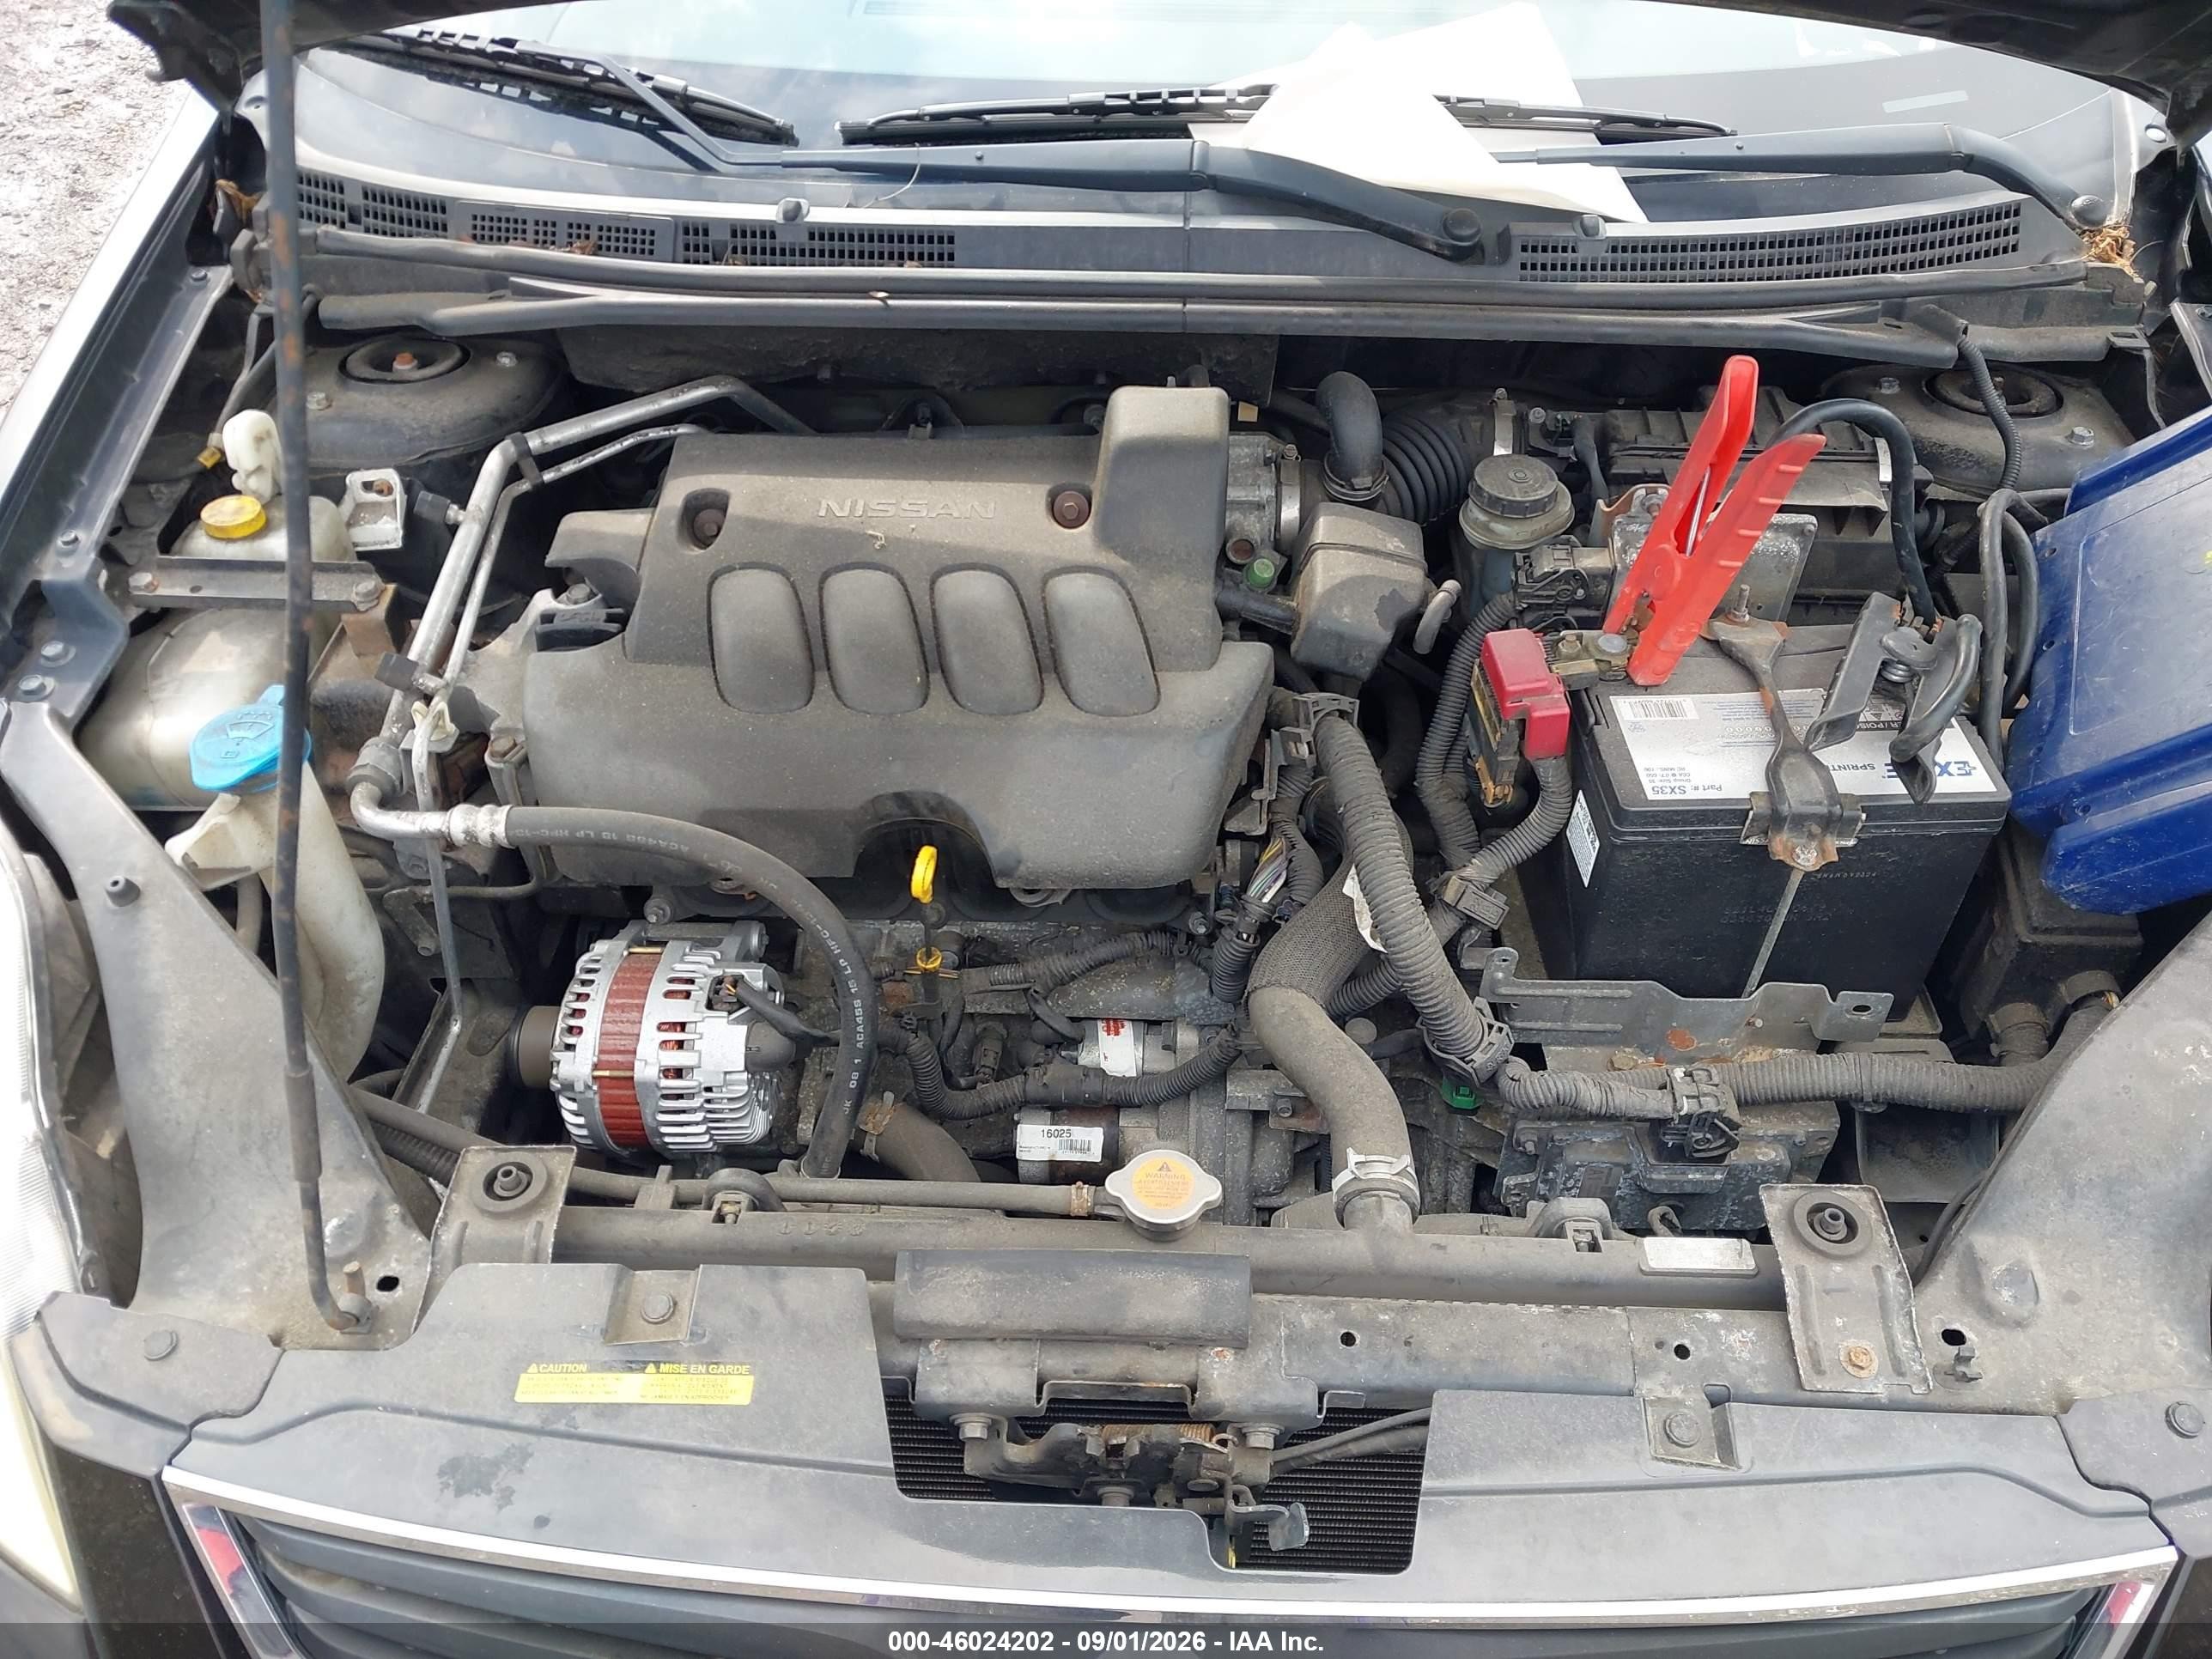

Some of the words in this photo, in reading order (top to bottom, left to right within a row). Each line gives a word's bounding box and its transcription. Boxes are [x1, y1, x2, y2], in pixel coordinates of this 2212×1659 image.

[817, 498, 997, 520] NISSAN
[1829, 763, 1876, 772] SPRINT
[1885, 760, 1975, 779] EXE
[1651, 785, 1686, 795] SX35
[574, 830, 595, 838] LP
[838, 957, 853, 975] LP
[1041, 1128, 1073, 1139] 16025
[1145, 1171, 1186, 1181] WARNING
[538, 1363, 587, 1374] CAUTION
[659, 1363, 688, 1374] MISE
[690, 1364, 707, 1374] EN
[708, 1364, 750, 1375] GARDE
